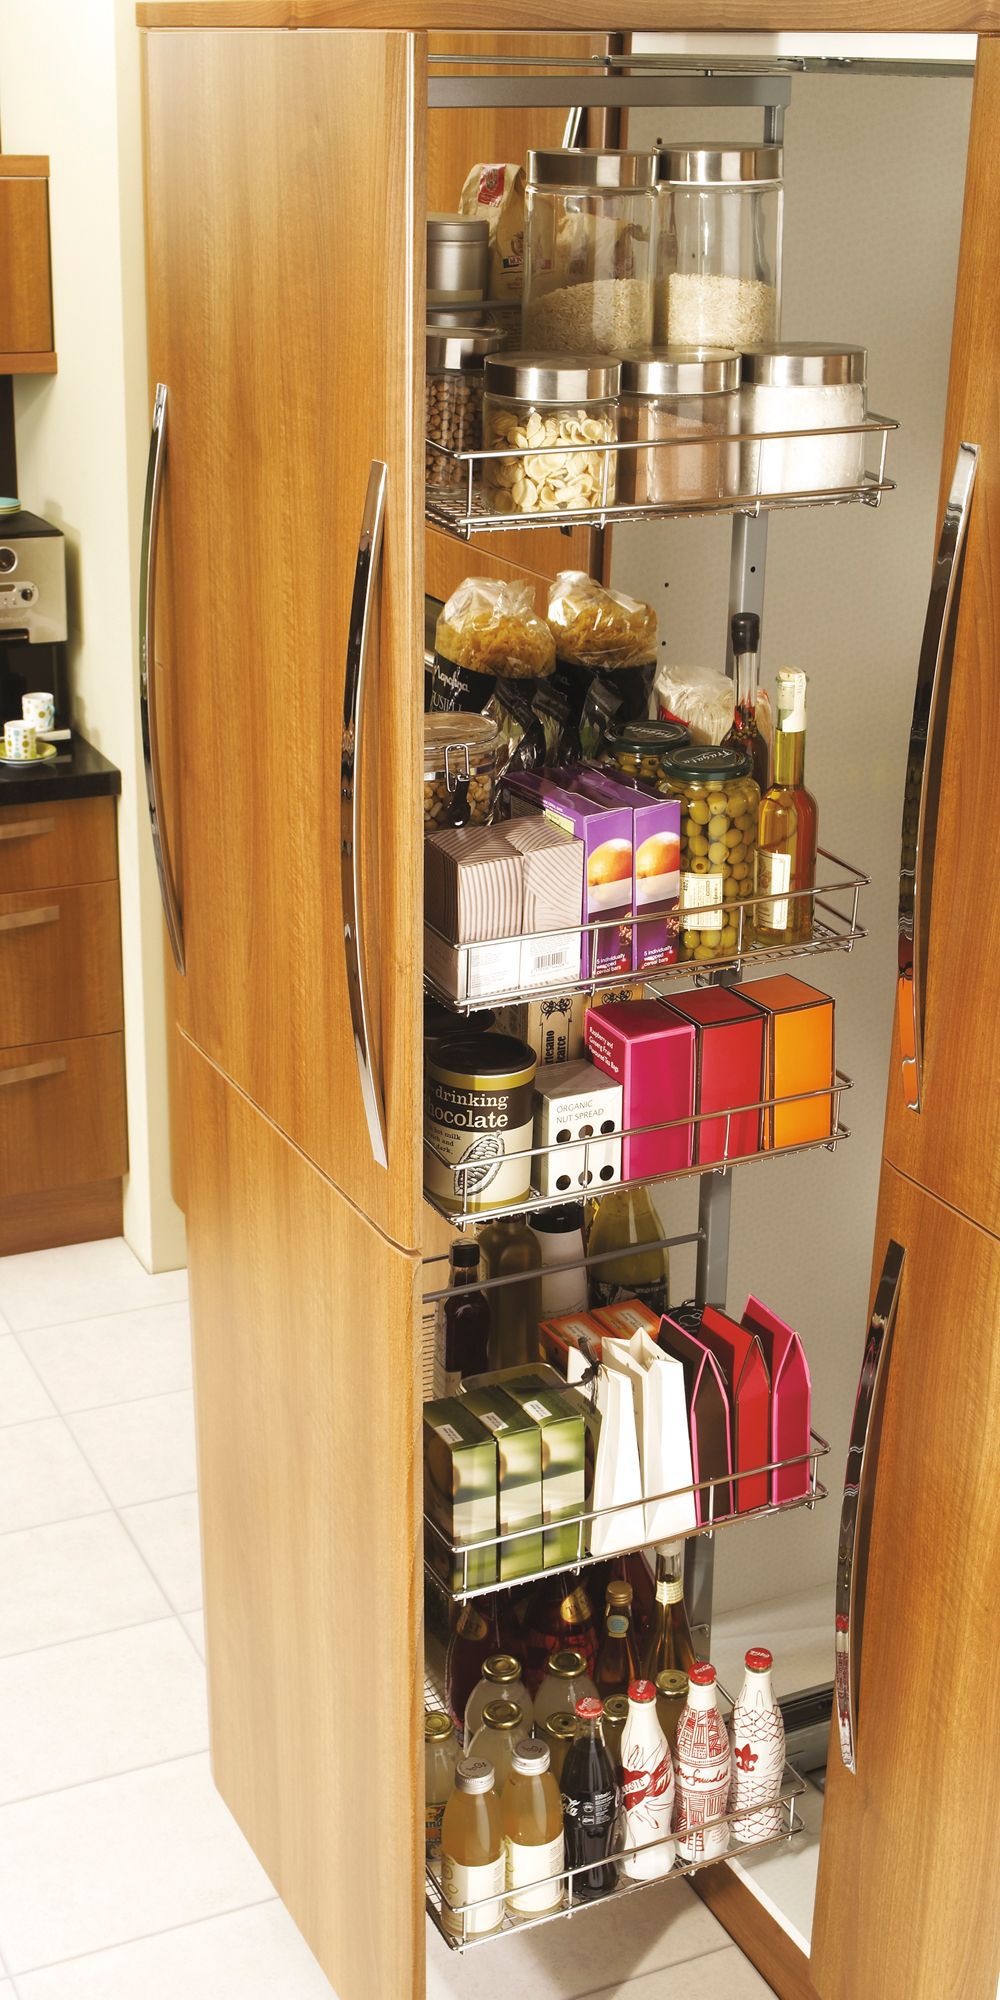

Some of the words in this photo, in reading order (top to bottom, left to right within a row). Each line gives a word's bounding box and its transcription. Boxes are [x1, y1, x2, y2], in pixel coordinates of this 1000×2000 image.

[648, 945, 673, 955] individually
[435, 1086, 509, 1110] drinking
[556, 1100, 593, 1113] ORGANIC
[429, 1104, 509, 1129] hocolate
[556, 1114, 573, 1124] NUT
[574, 1108, 605, 1120] SPREAD
[441, 1139, 454, 1147] and
[444, 1132, 461, 1141] milk
[622, 1779, 645, 1793] USIC
